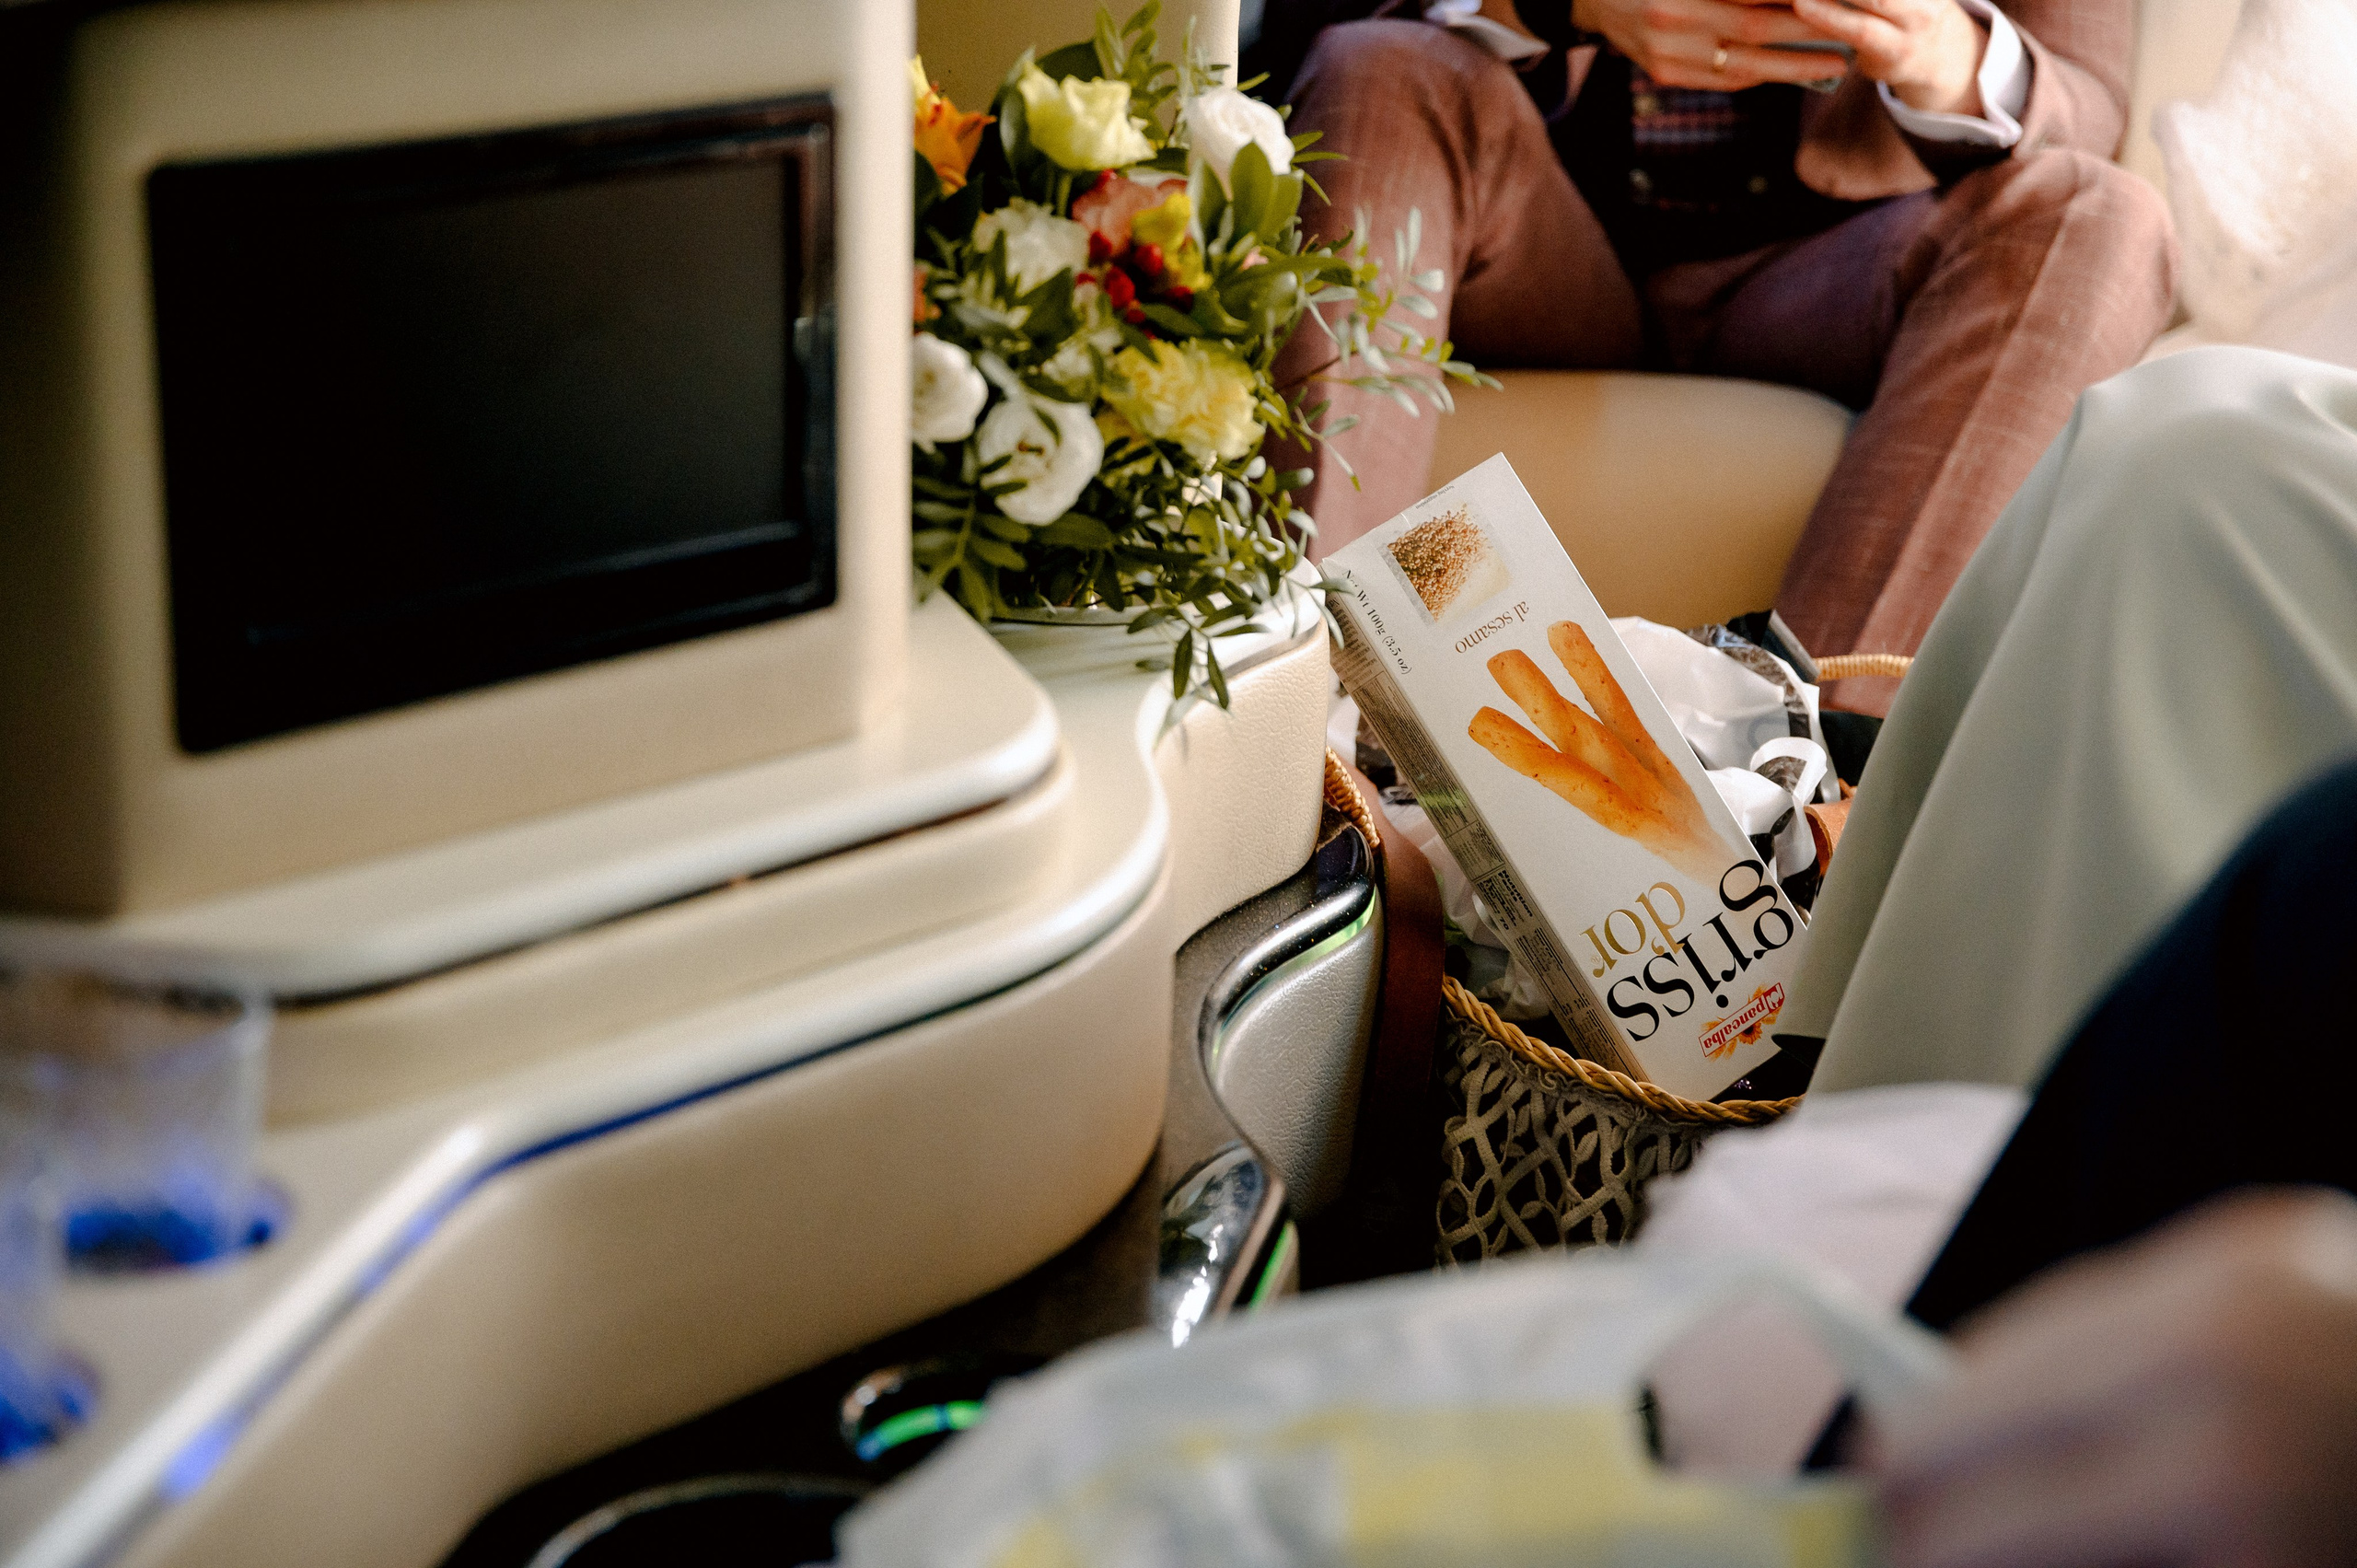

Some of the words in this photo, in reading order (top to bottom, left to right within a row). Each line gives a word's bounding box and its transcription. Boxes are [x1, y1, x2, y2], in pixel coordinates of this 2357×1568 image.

[1356, 589, 1370, 608] Wt
[1367, 609, 1387, 635] 100g
[1382, 635, 1402, 656] (3.5
[1397, 657, 1412, 675] oz)
[1455, 610, 1514, 654] sesamo
[1514, 601, 1529, 622] al
[1502, 869, 1533, 917] Nutrition
[1499, 916, 1509, 930] 70
[1607, 859, 1794, 1042] griss
